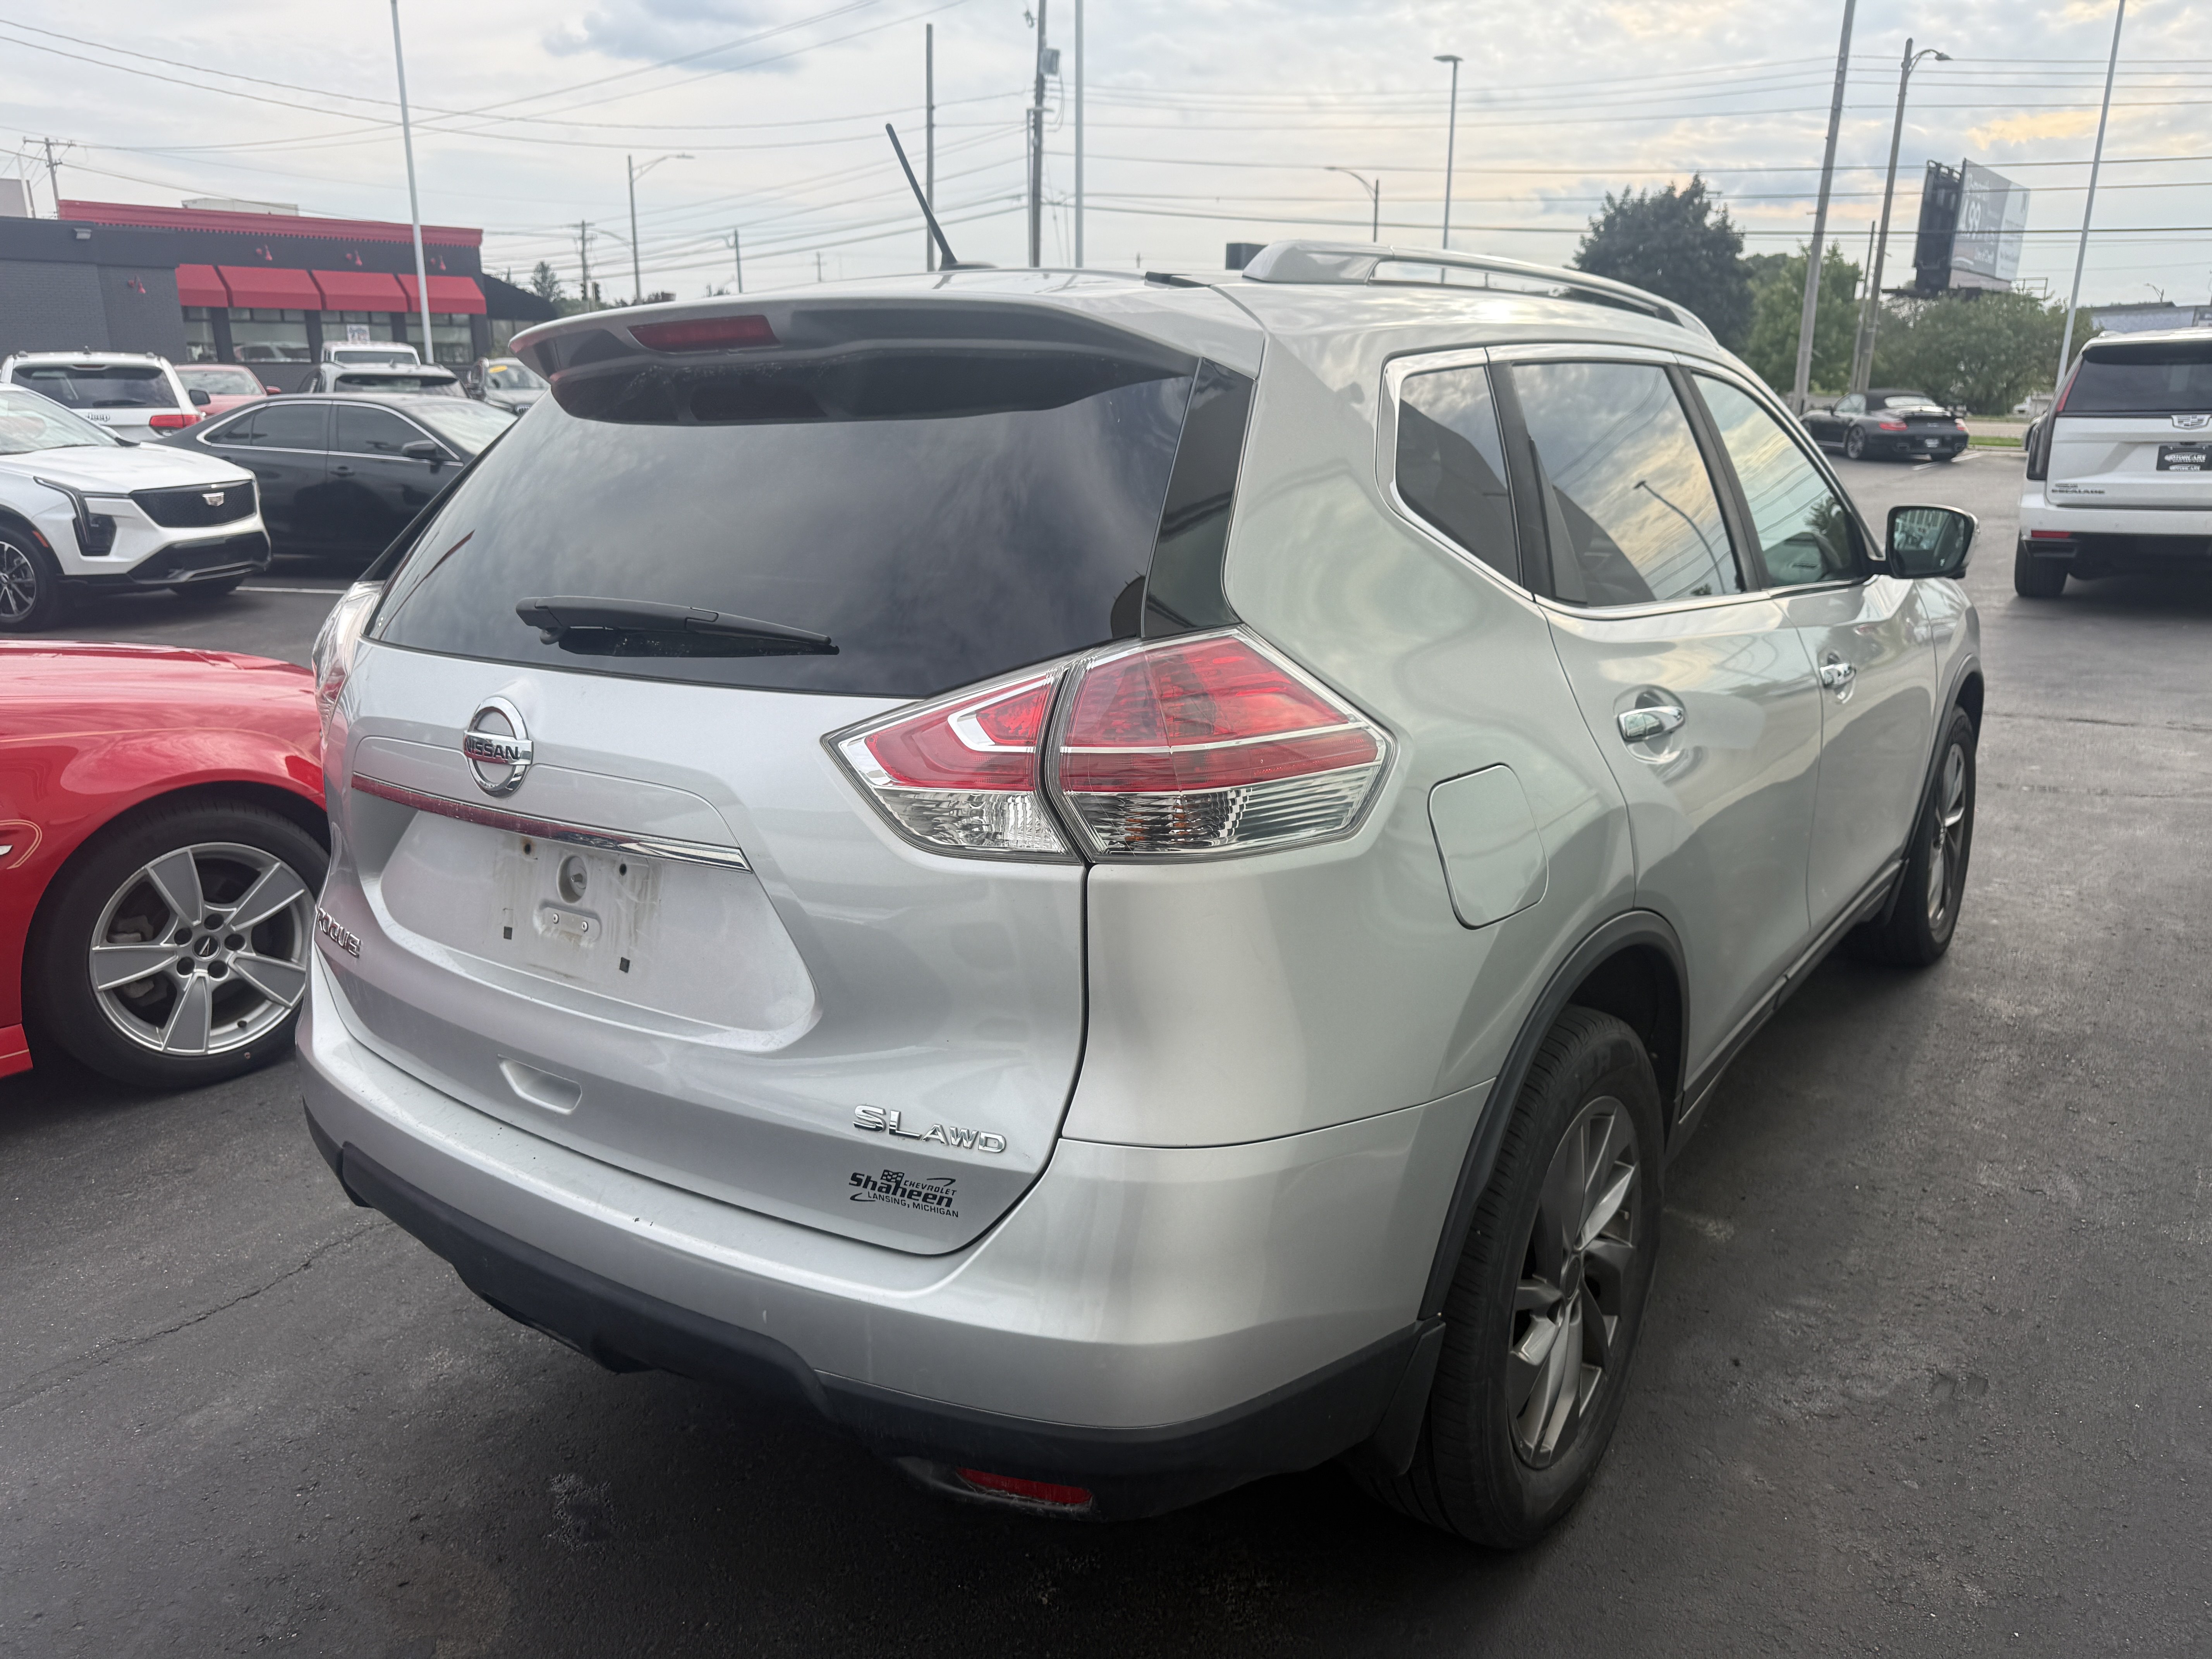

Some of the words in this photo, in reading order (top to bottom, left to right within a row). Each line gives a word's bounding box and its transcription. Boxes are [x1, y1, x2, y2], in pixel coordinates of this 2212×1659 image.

[87, 412, 110, 422] Jeep
[465, 737, 519, 760] NISSAN
[853, 1105, 922, 1140] SL
[920, 1124, 1006, 1153] AWD
[849, 1171, 953, 1208] Shaheen
[903, 1180, 957, 1196] CHEVROLET
[868, 1191, 910, 1208] LANSING,
[912, 1202, 959, 1218] MICHIGAN
